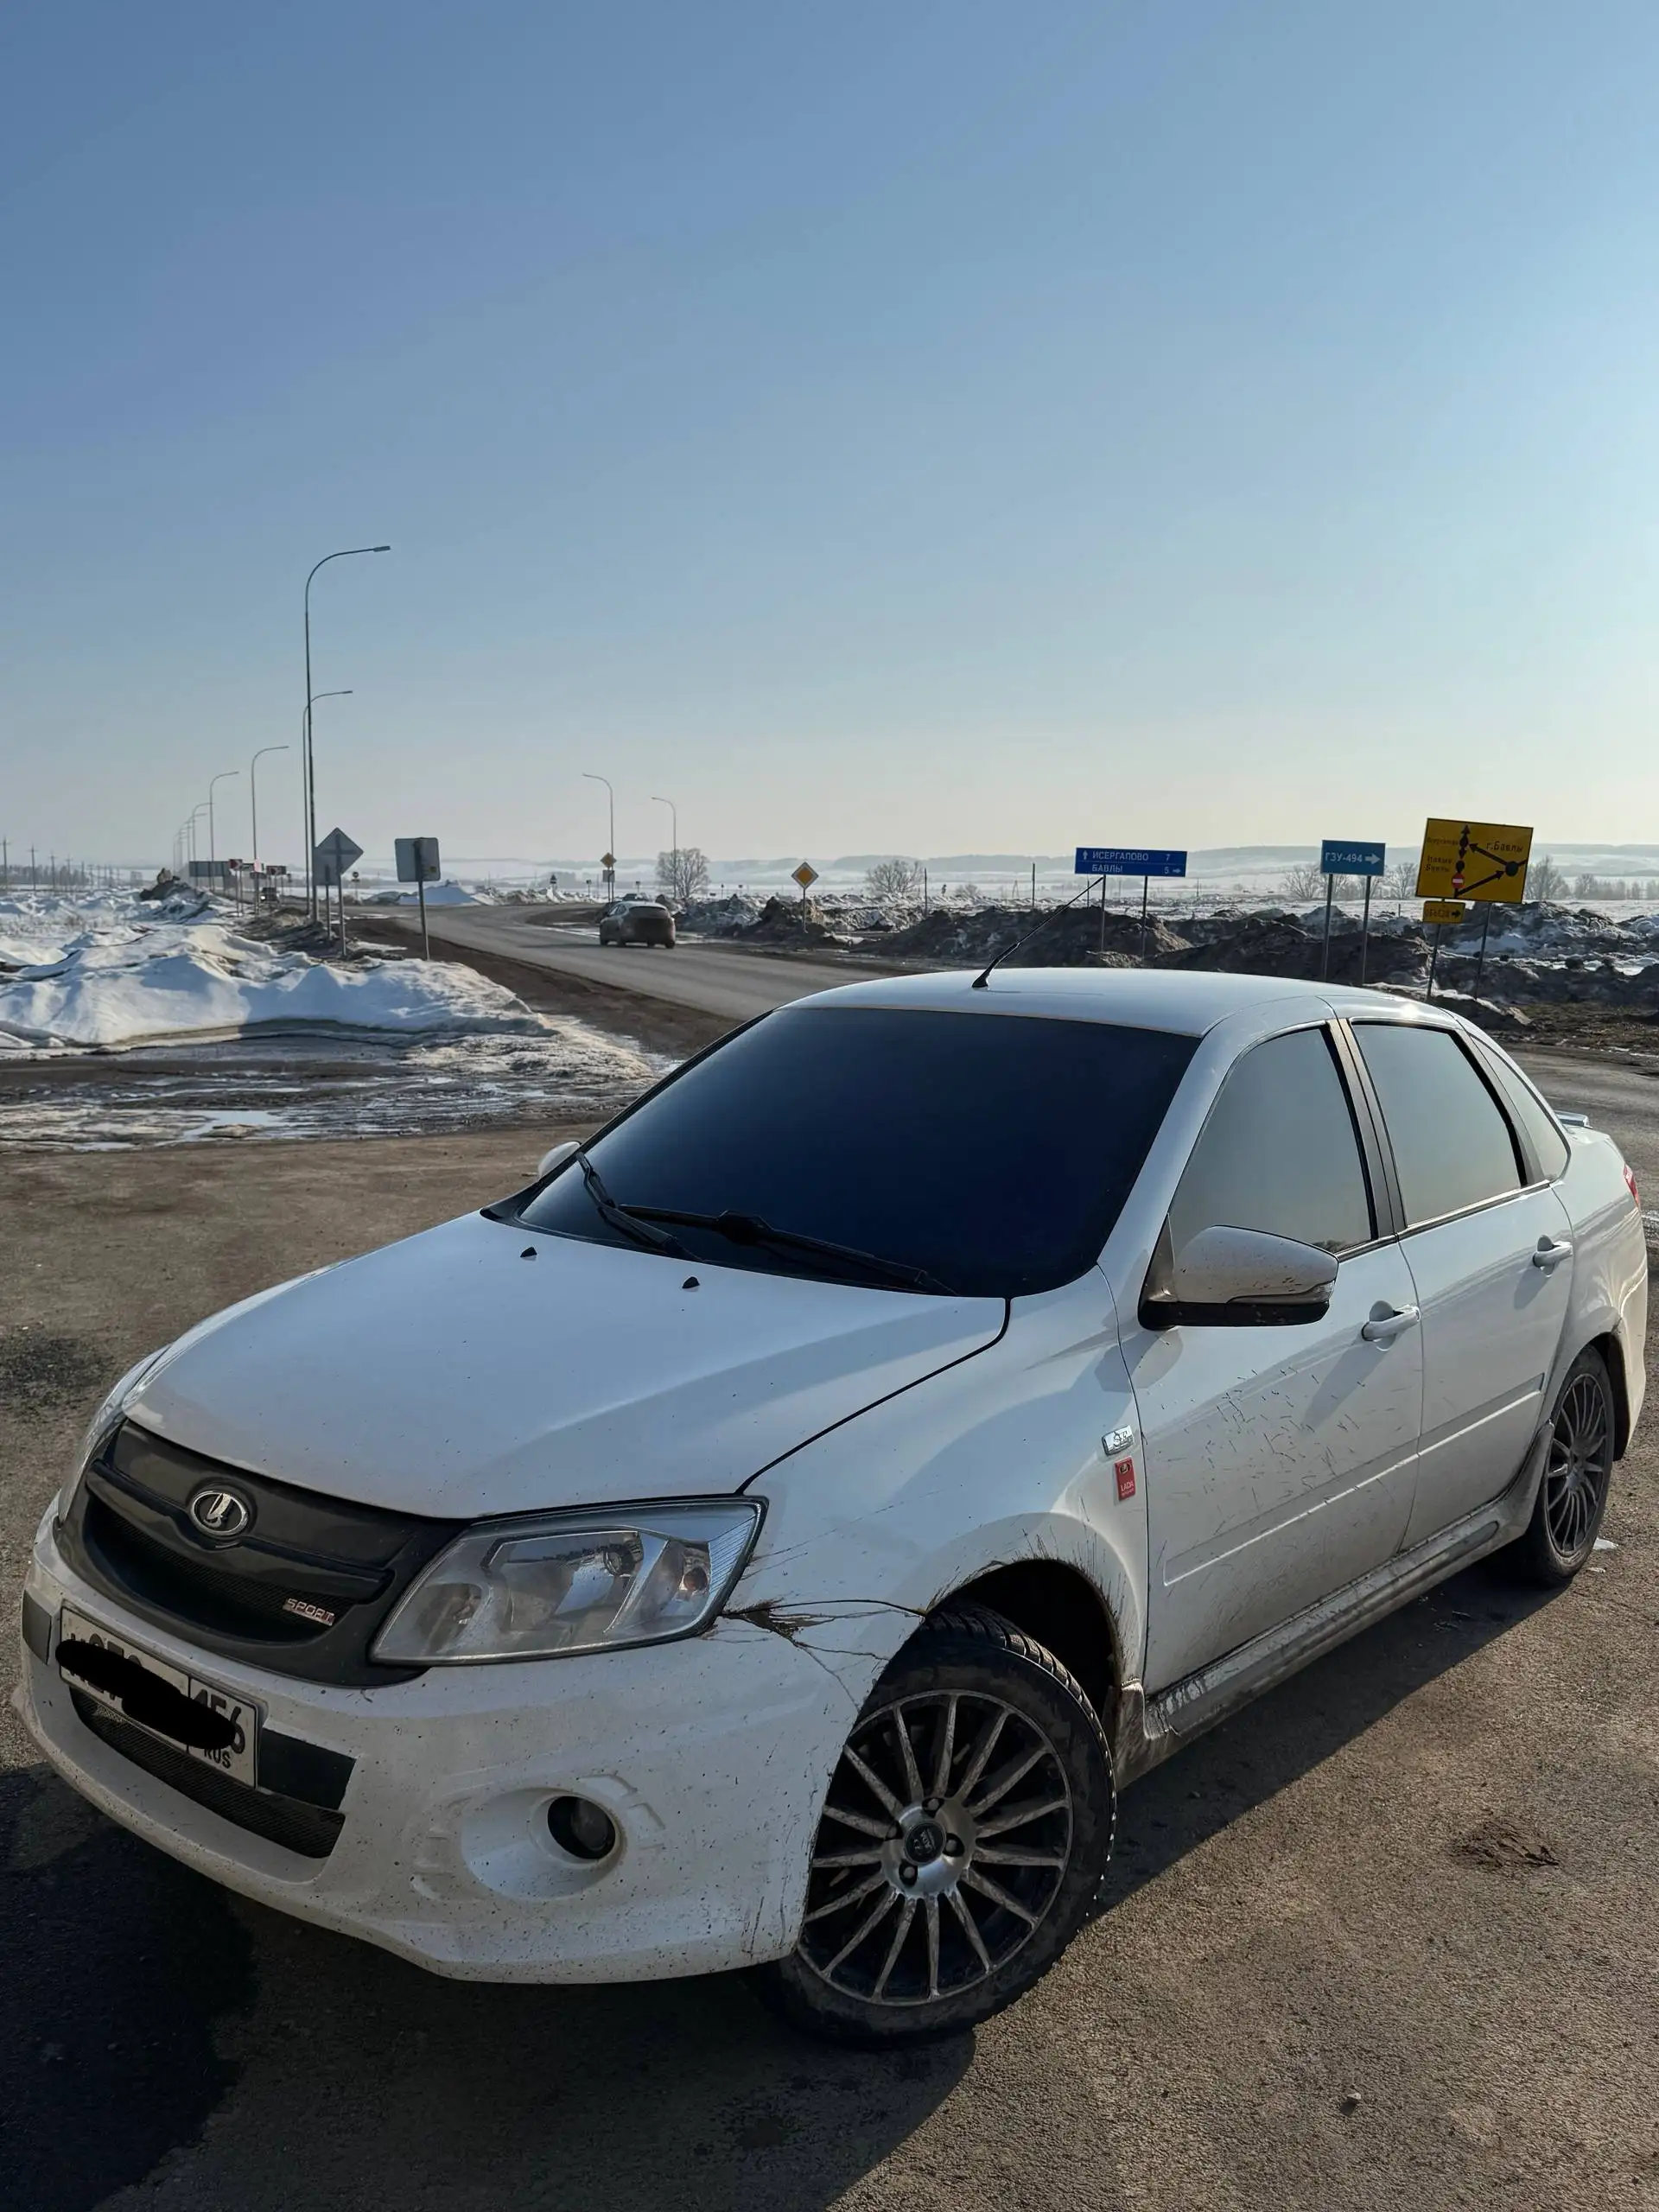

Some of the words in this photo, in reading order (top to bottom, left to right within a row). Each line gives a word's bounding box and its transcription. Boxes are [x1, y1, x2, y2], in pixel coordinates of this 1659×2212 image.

[1092, 851, 1148, 861] ИСЕРГАПОВО
[1165, 854, 1170, 862] 7
[1325, 852, 1362, 862] ГЗУ-494
[1091, 864, 1122, 873] БАВЛЫ
[287, 1598, 335, 1624] SPORT
